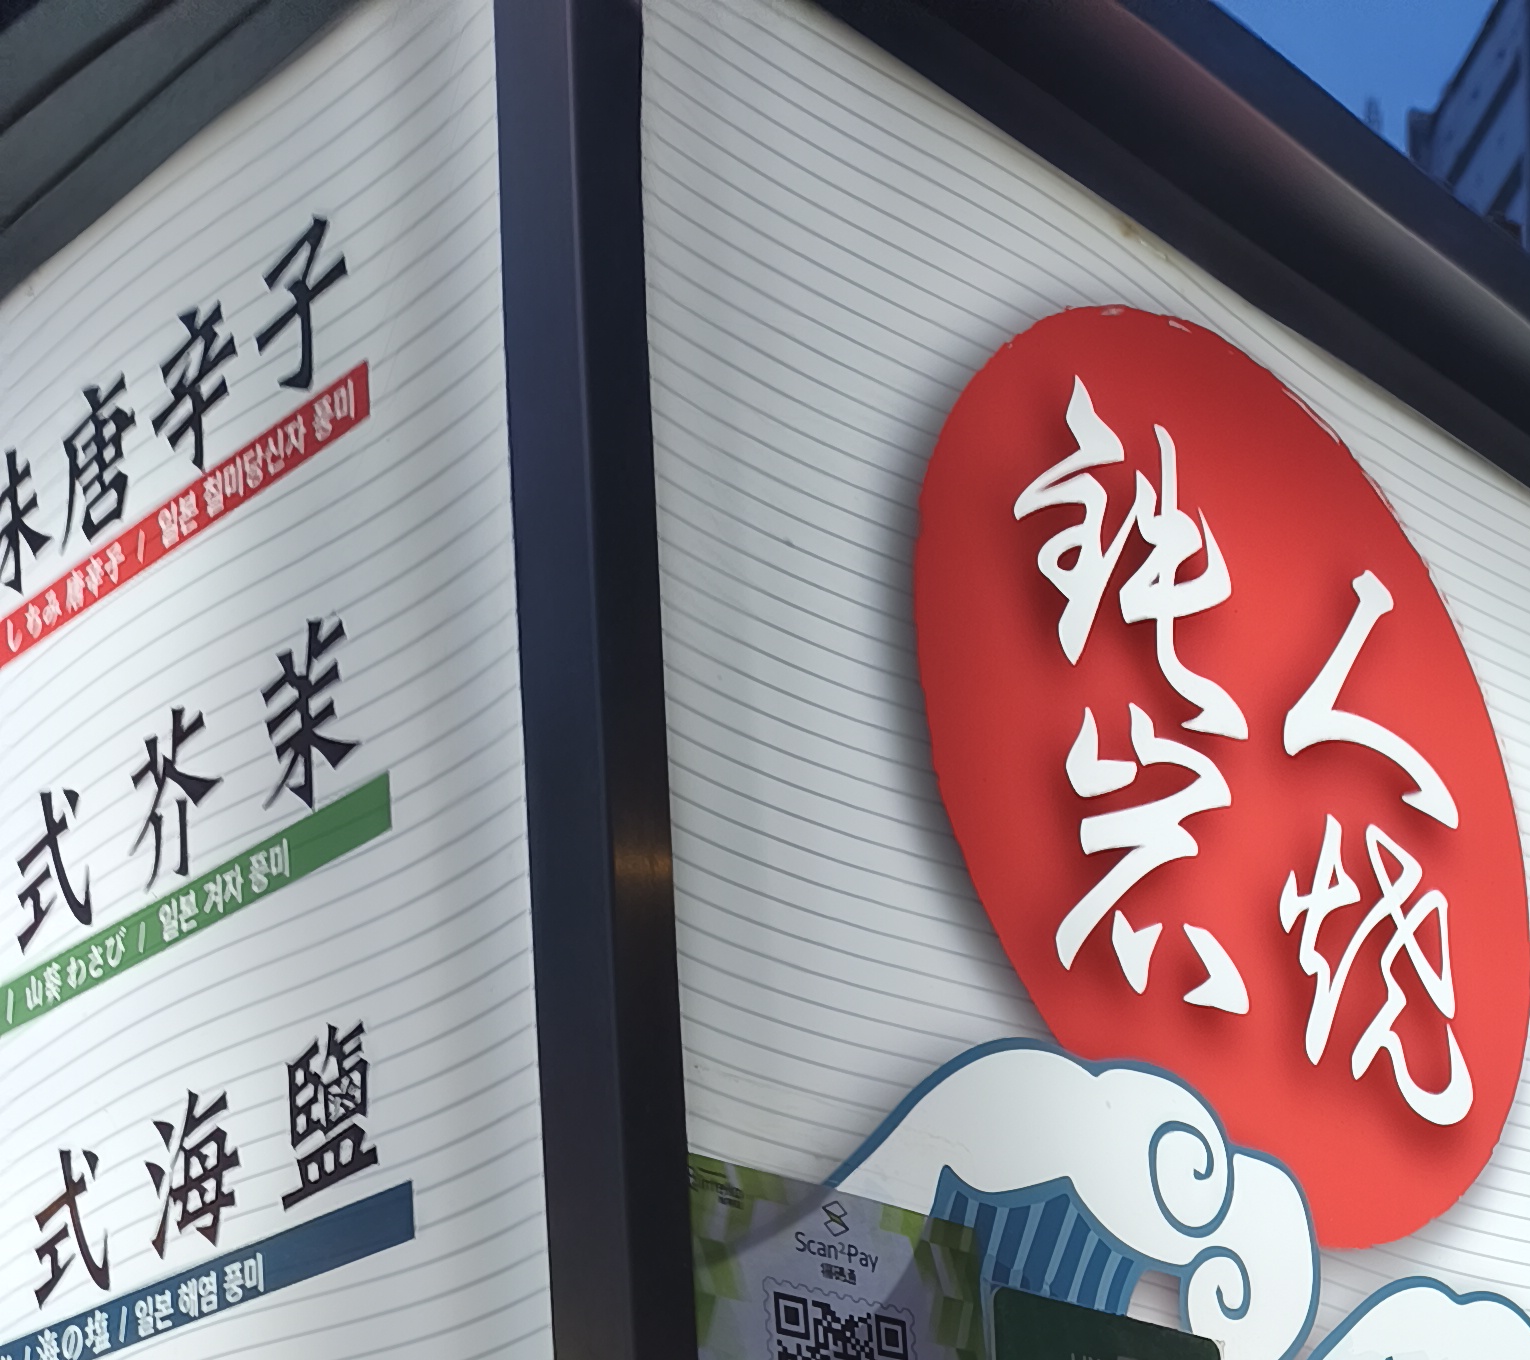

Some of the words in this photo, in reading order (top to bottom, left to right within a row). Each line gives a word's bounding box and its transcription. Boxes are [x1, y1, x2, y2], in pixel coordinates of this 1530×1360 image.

[157, 490, 199, 549] 일본
[158, 889, 199, 942] 일본
[34, 1020, 380, 1311] 式海鹽
[135, 1289, 175, 1338] 일본
[222, 1252, 265, 1304] 풍미
